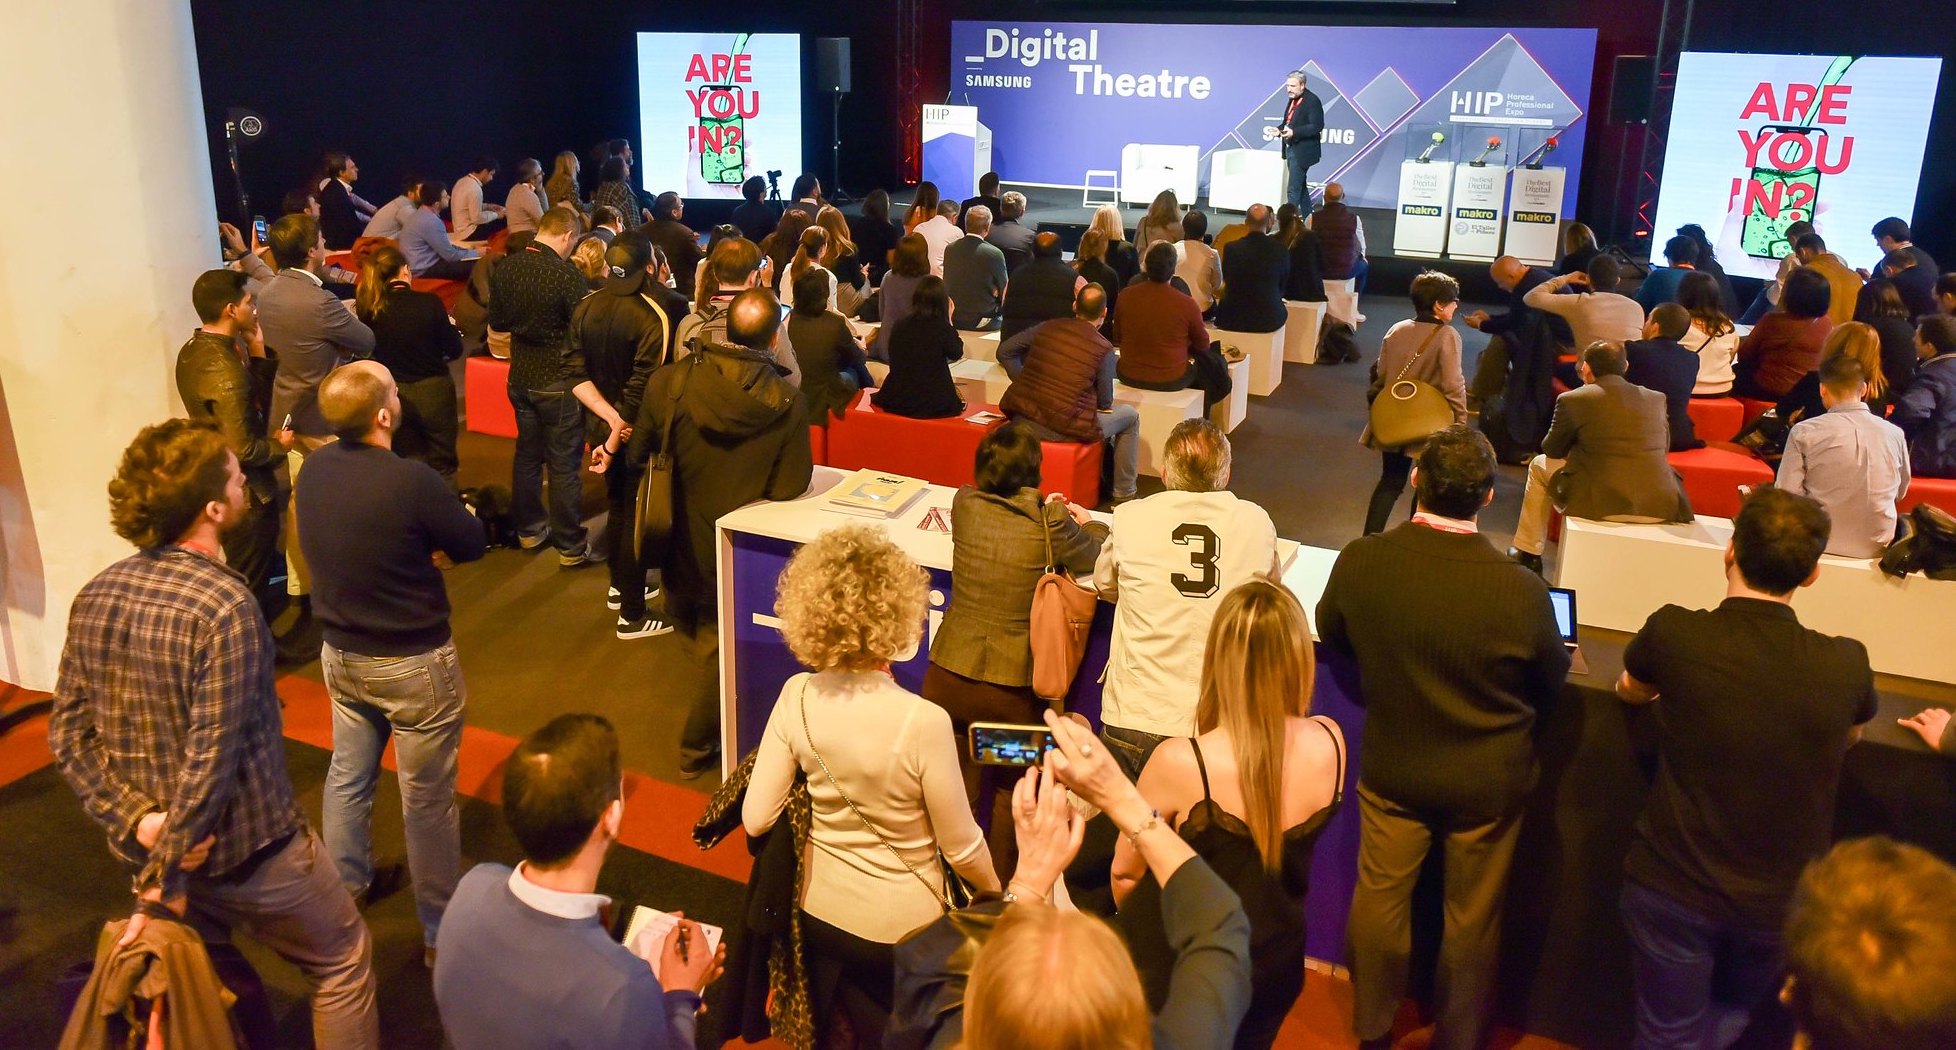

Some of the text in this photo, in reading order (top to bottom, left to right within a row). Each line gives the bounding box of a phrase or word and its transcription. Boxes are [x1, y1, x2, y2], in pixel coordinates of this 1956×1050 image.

[685, 53, 752, 83] ARE
[965, 74, 1032, 89] SAMSUNG
[1068, 64, 1212, 100] Theatre
[1450, 90, 1503, 115] HIP
[1507, 93, 1535, 101] Horeca
[1739, 82, 1853, 125] ARE
[685, 89, 759, 119] YOU
[1505, 101, 1554, 109] Professional
[1505, 108, 1525, 116] Expo
[1737, 130, 1855, 175] YOU
[1467, 182, 1493, 191] Digital
[1524, 185, 1551, 194] Digital
[1405, 206, 1439, 216] makro
[1459, 209, 1494, 219] makro
[1516, 212, 1552, 223] makro
[1170, 522, 1221, 599] 3
